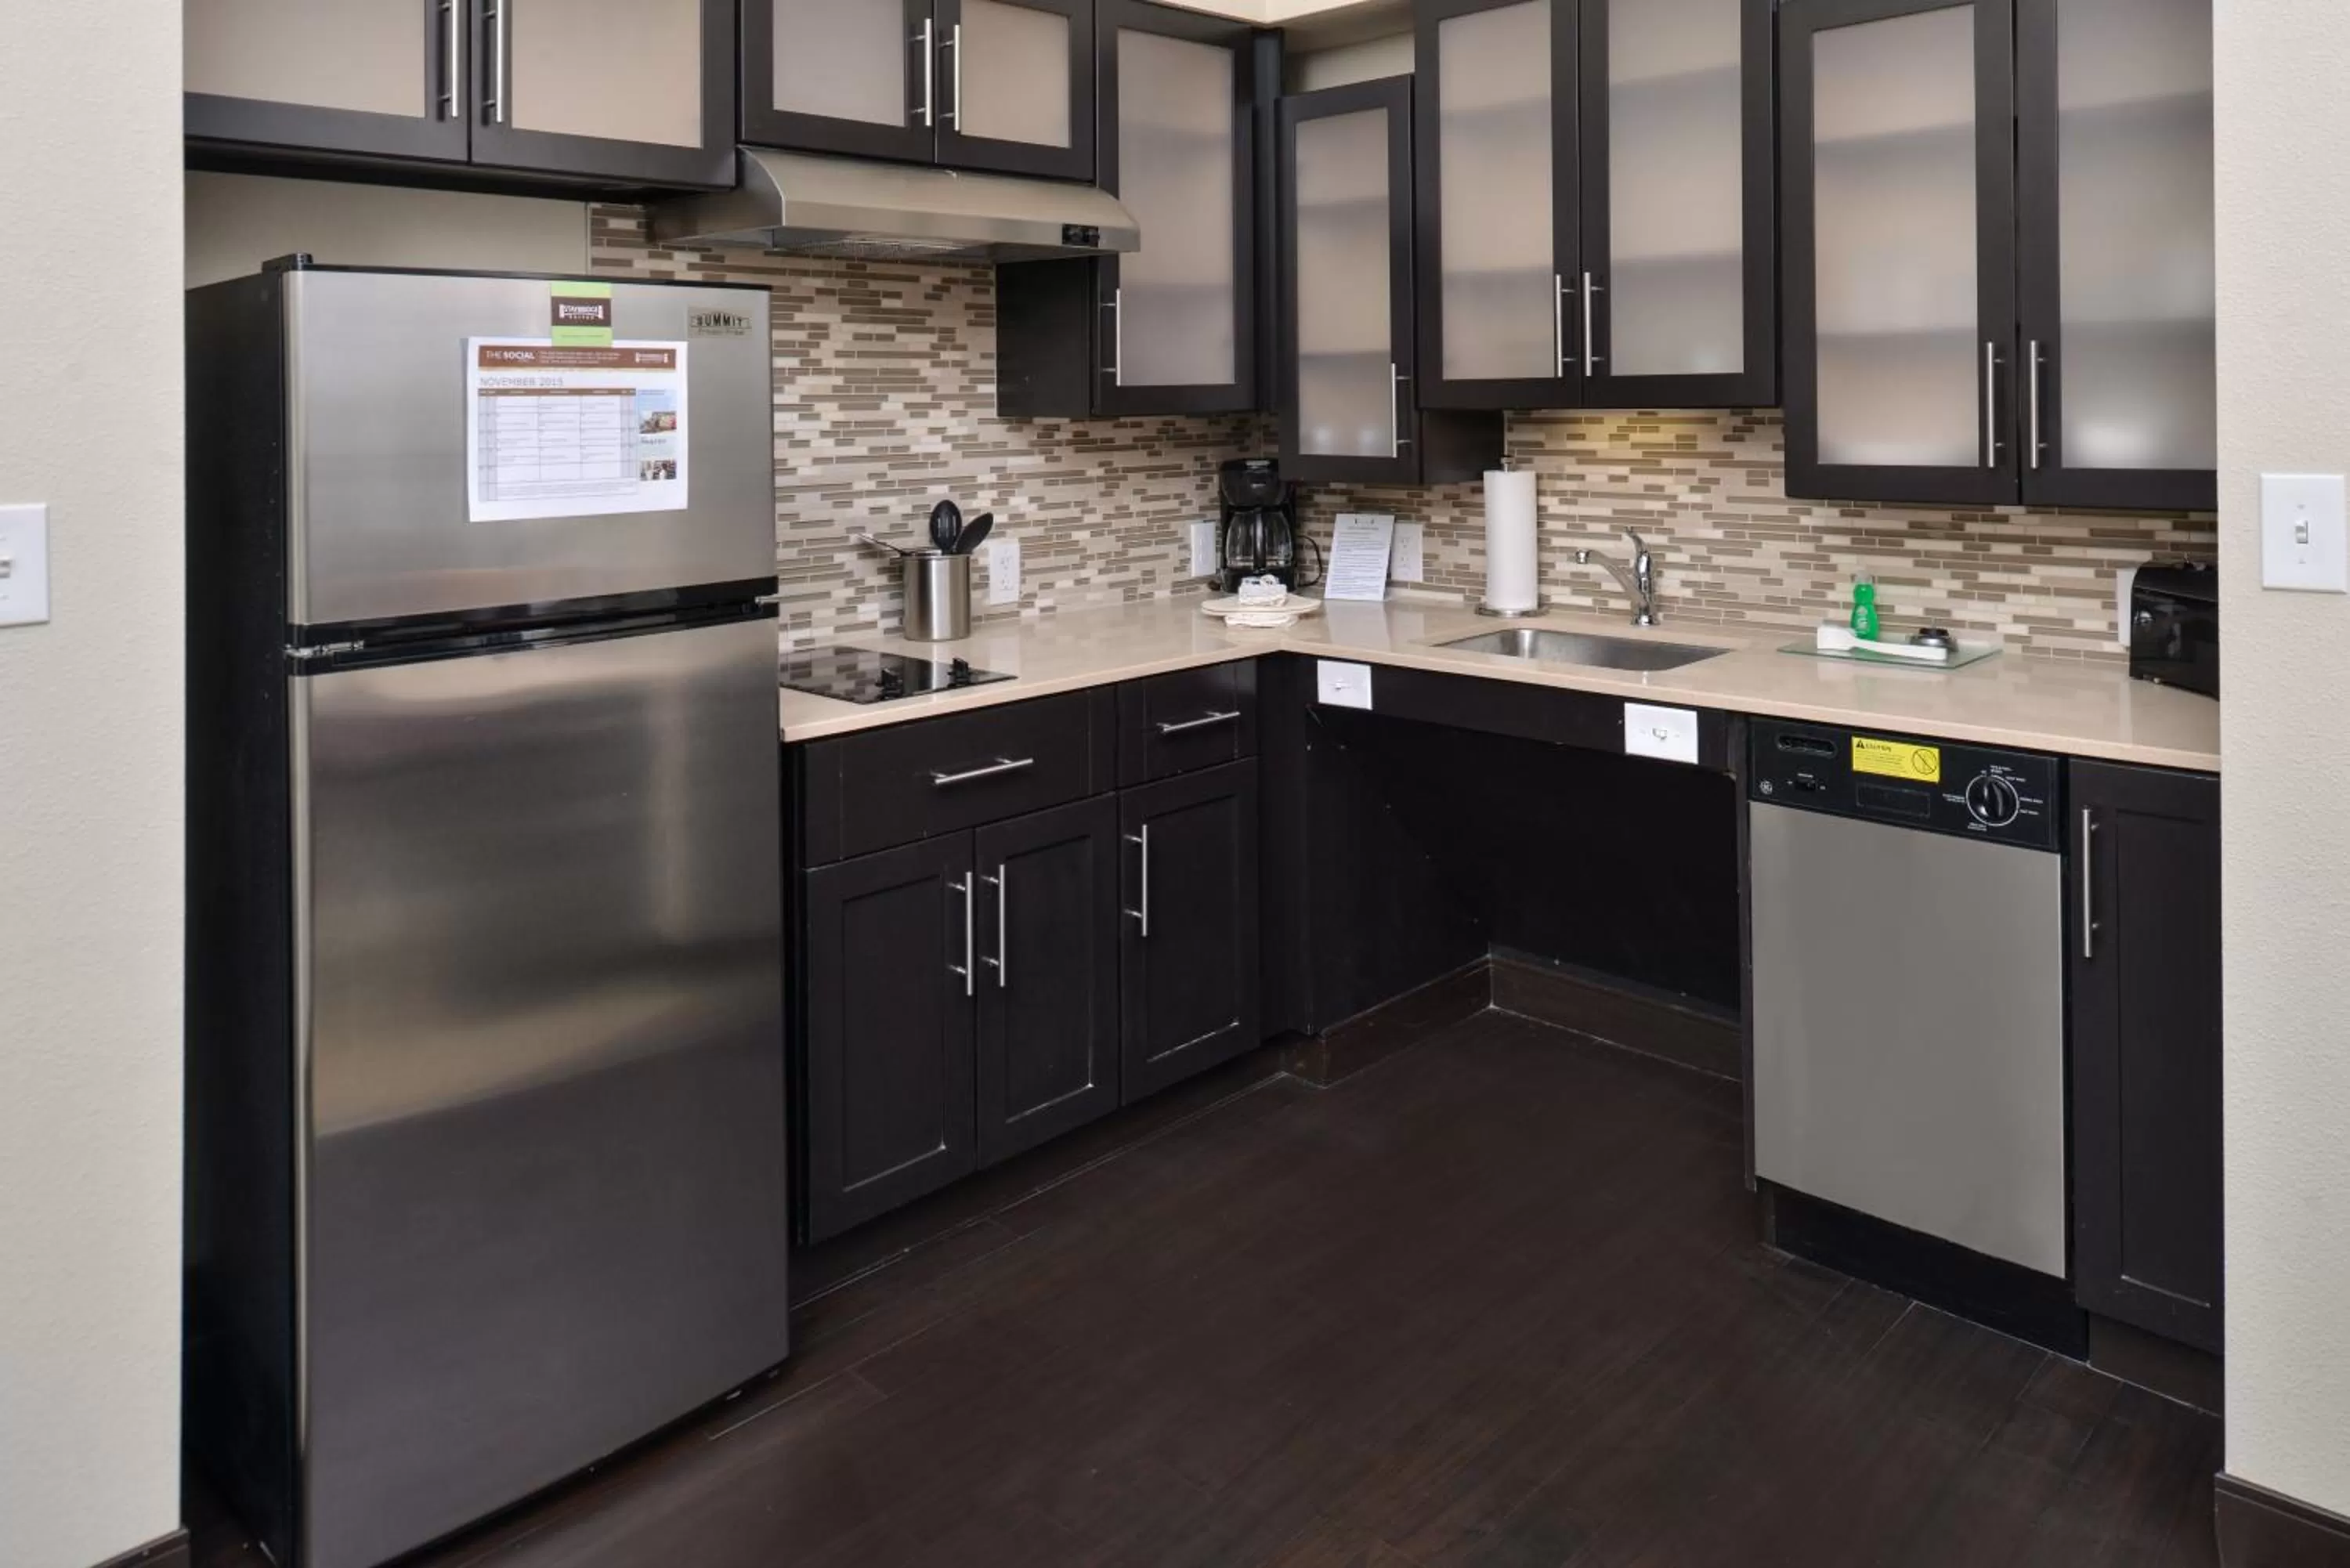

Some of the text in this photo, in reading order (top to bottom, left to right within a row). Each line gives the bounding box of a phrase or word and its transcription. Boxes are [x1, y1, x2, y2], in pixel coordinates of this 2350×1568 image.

[696, 313, 743, 327] SUMMIT
[502, 351, 535, 360] SOCIAL
[480, 377, 536, 386] NOVEMBER
